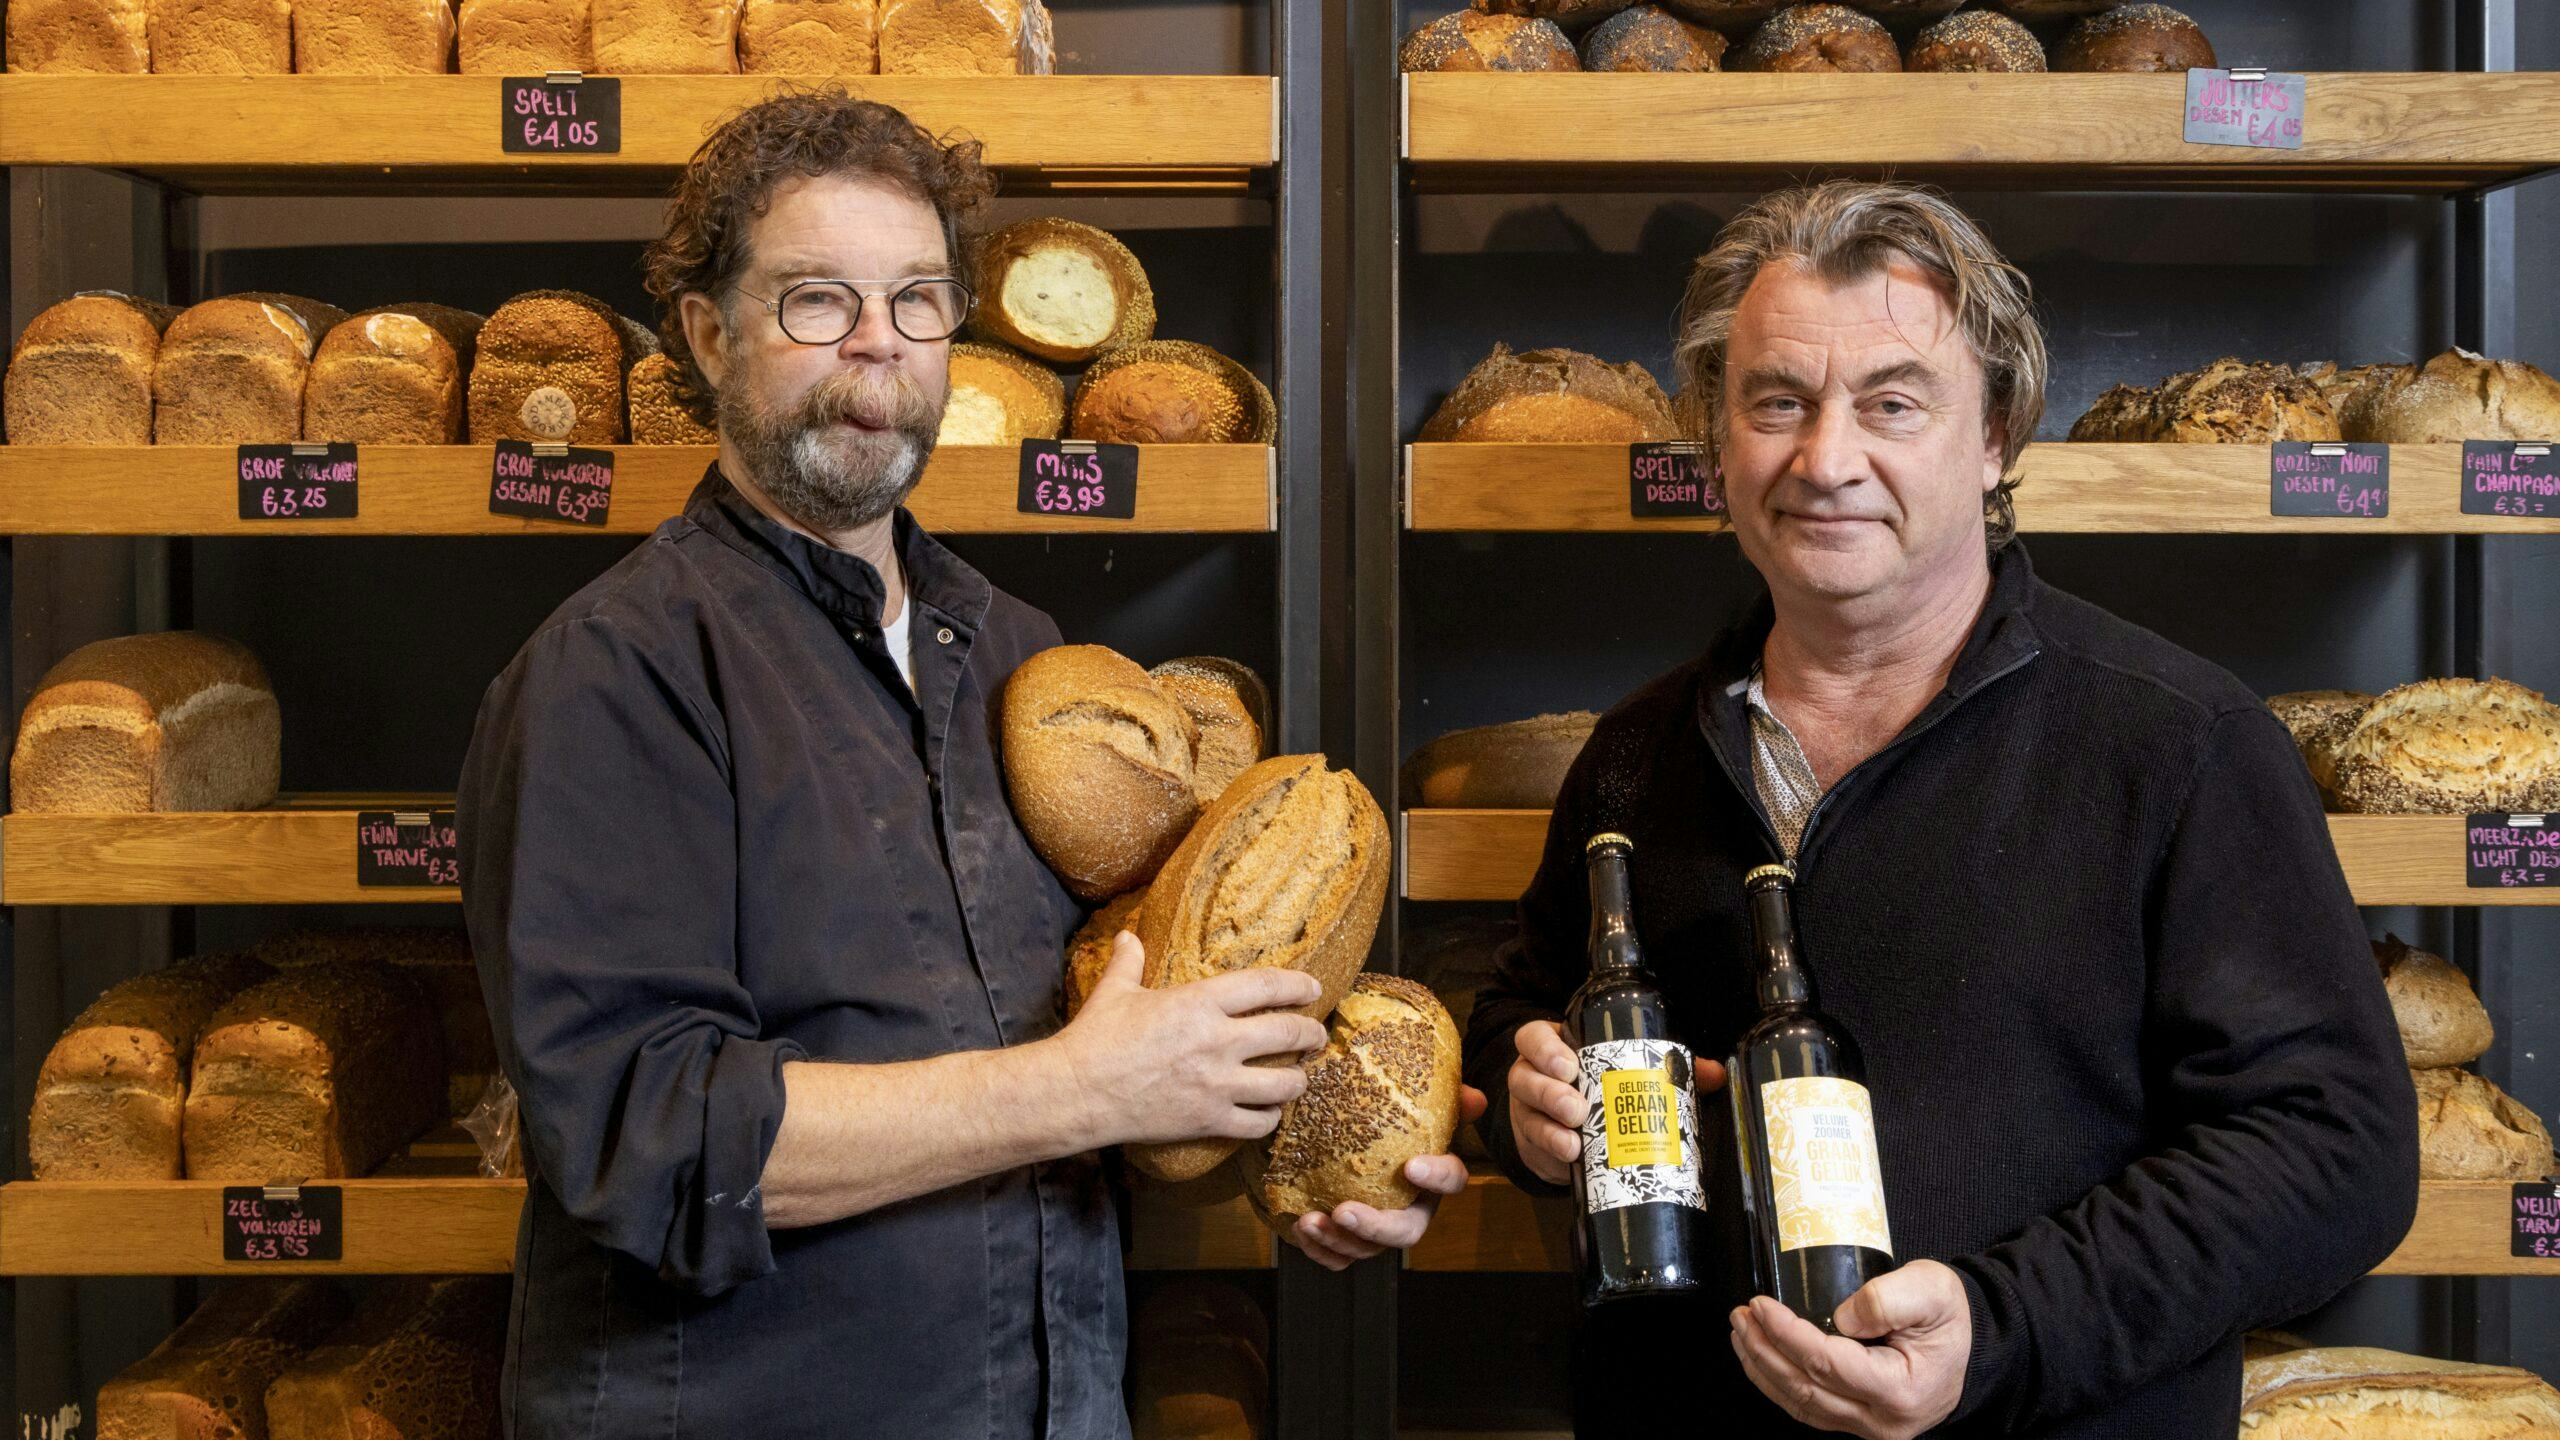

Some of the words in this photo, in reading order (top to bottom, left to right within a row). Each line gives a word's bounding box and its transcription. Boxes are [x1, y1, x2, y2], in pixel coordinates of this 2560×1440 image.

[514, 88, 577, 115] SPELT
[2190, 106, 2242, 126] DESEM
[524, 117, 598, 148] €4.05
[241, 457, 285, 481] GROF
[496, 452, 538, 478] GROF
[2340, 452, 2382, 475] NOOT
[2466, 452, 2502, 472] PAIN
[1646, 484, 1697, 502] DESEM
[2284, 476, 2335, 493] DESEM
[262, 486, 327, 516] €3.25
[1036, 480, 1105, 512] €3.95
[373, 848, 428, 866] TARWE
[2473, 849, 2519, 867] LICHT
[1619, 1081, 1661, 1094] GELDERS
[1614, 1094, 1668, 1115] GRAAN
[1617, 1115, 1669, 1135] GELUK
[1812, 1113, 1851, 1127] VELUWE
[1814, 1126, 1852, 1140] ZOOMER
[1806, 1140, 1861, 1162] GRAAN
[1811, 1161, 1863, 1184] GELUK
[239, 1219, 321, 1236] VOLKOREN
